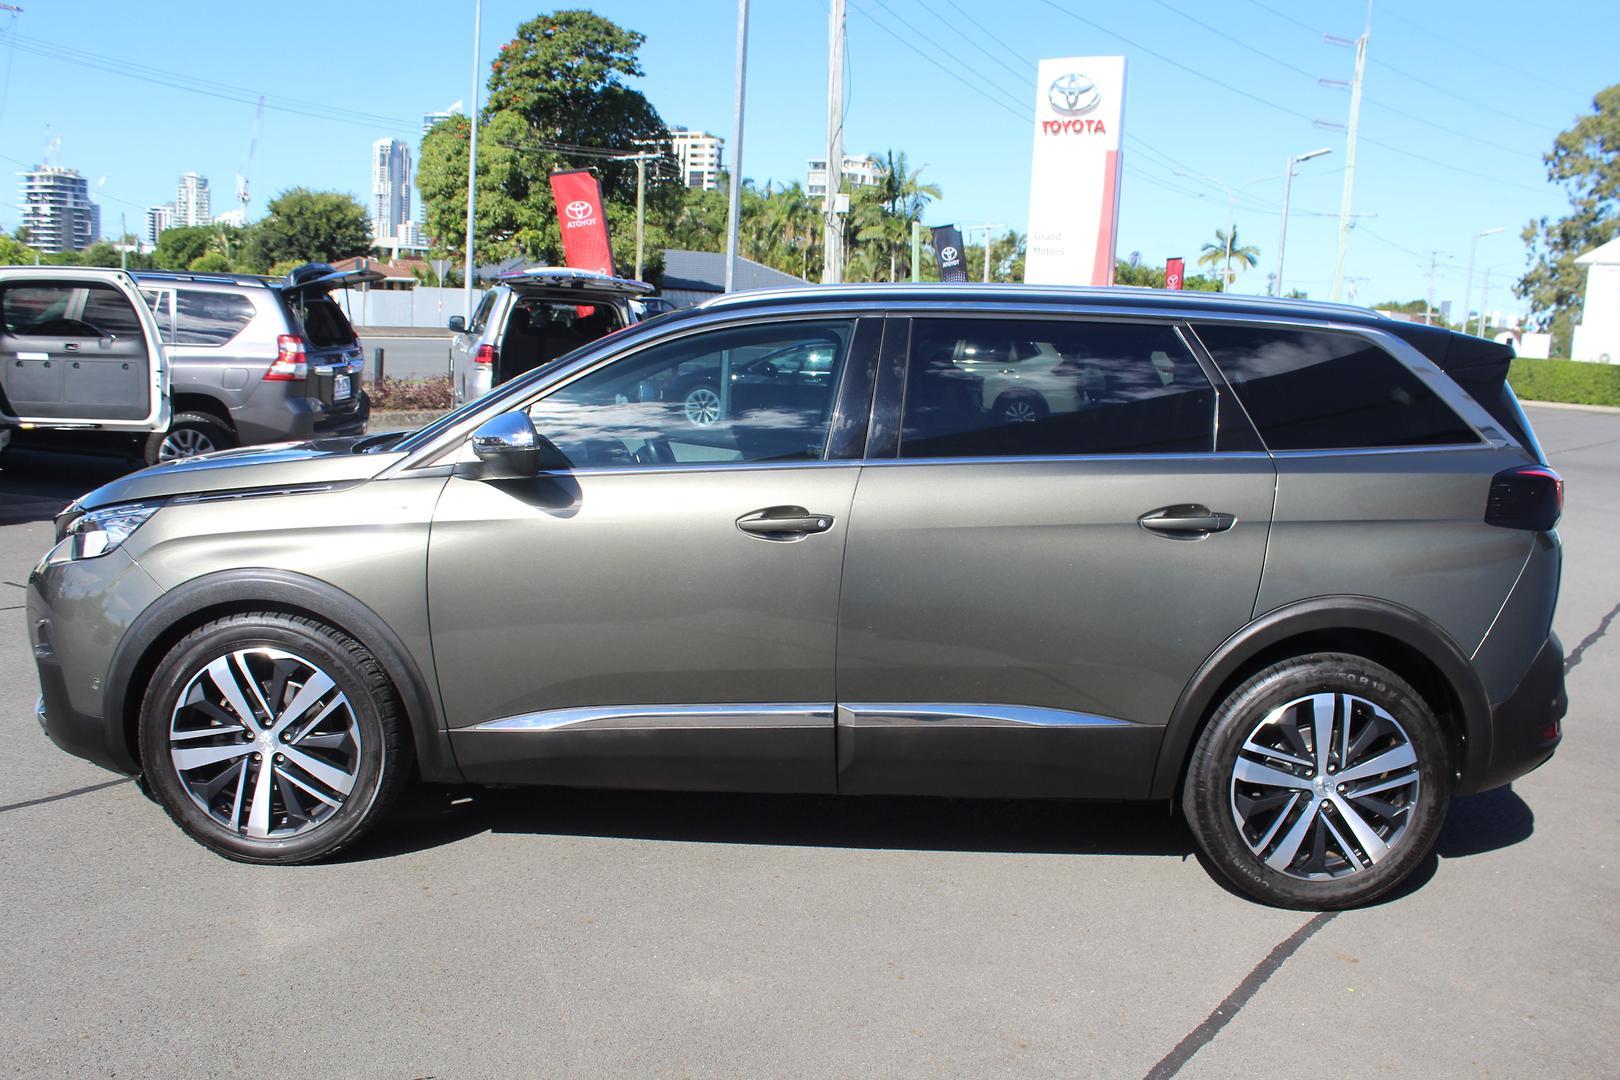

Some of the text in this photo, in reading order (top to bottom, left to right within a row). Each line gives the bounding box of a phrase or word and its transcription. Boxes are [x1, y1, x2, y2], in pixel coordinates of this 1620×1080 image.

[1042, 119, 1106, 135] TOYOTA
[1033, 231, 1062, 241] Grand
[1033, 247, 1065, 256] Motors
